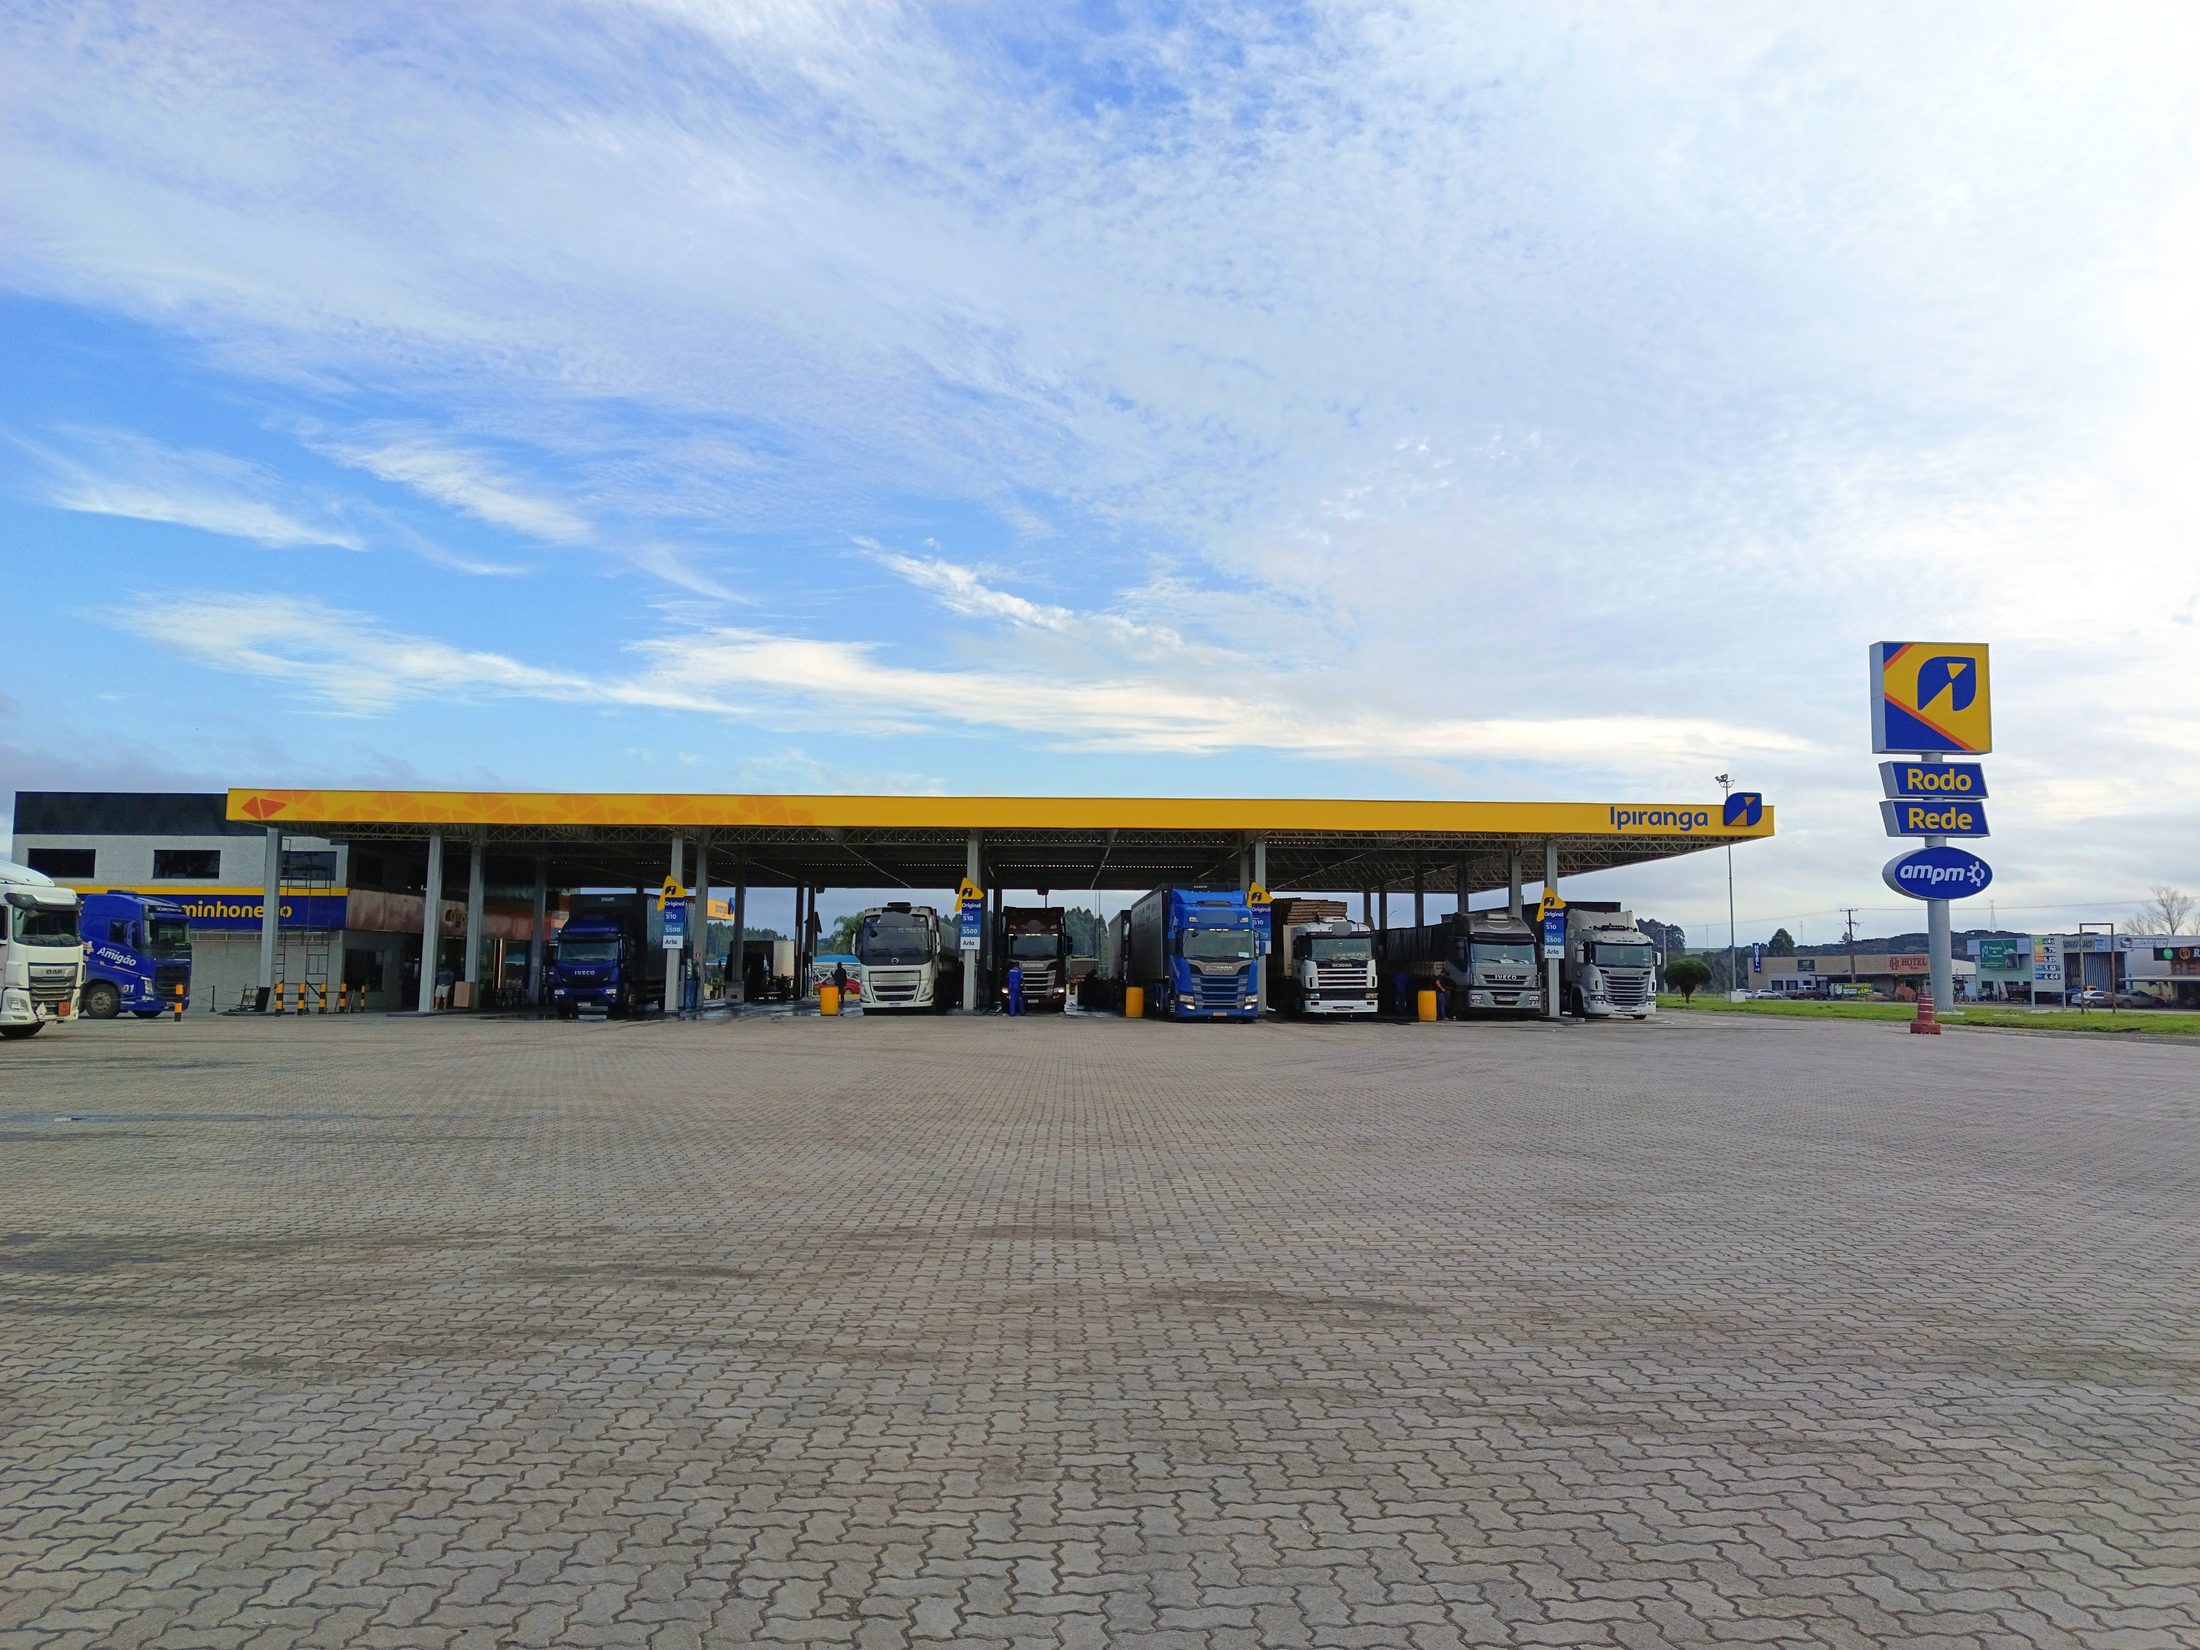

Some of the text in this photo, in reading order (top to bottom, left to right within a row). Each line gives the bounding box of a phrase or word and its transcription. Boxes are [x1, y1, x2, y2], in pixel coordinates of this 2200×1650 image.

[1907, 767, 1972, 791] Rodo
[1610, 806, 1709, 832] Ipiranga
[1908, 807, 1973, 830] Rede
[1900, 864, 1965, 885] ampm
[96, 946, 137, 966] Amigão
[1901, 957, 1928, 966] HOTEL
[122, 984, 135, 993] 01
